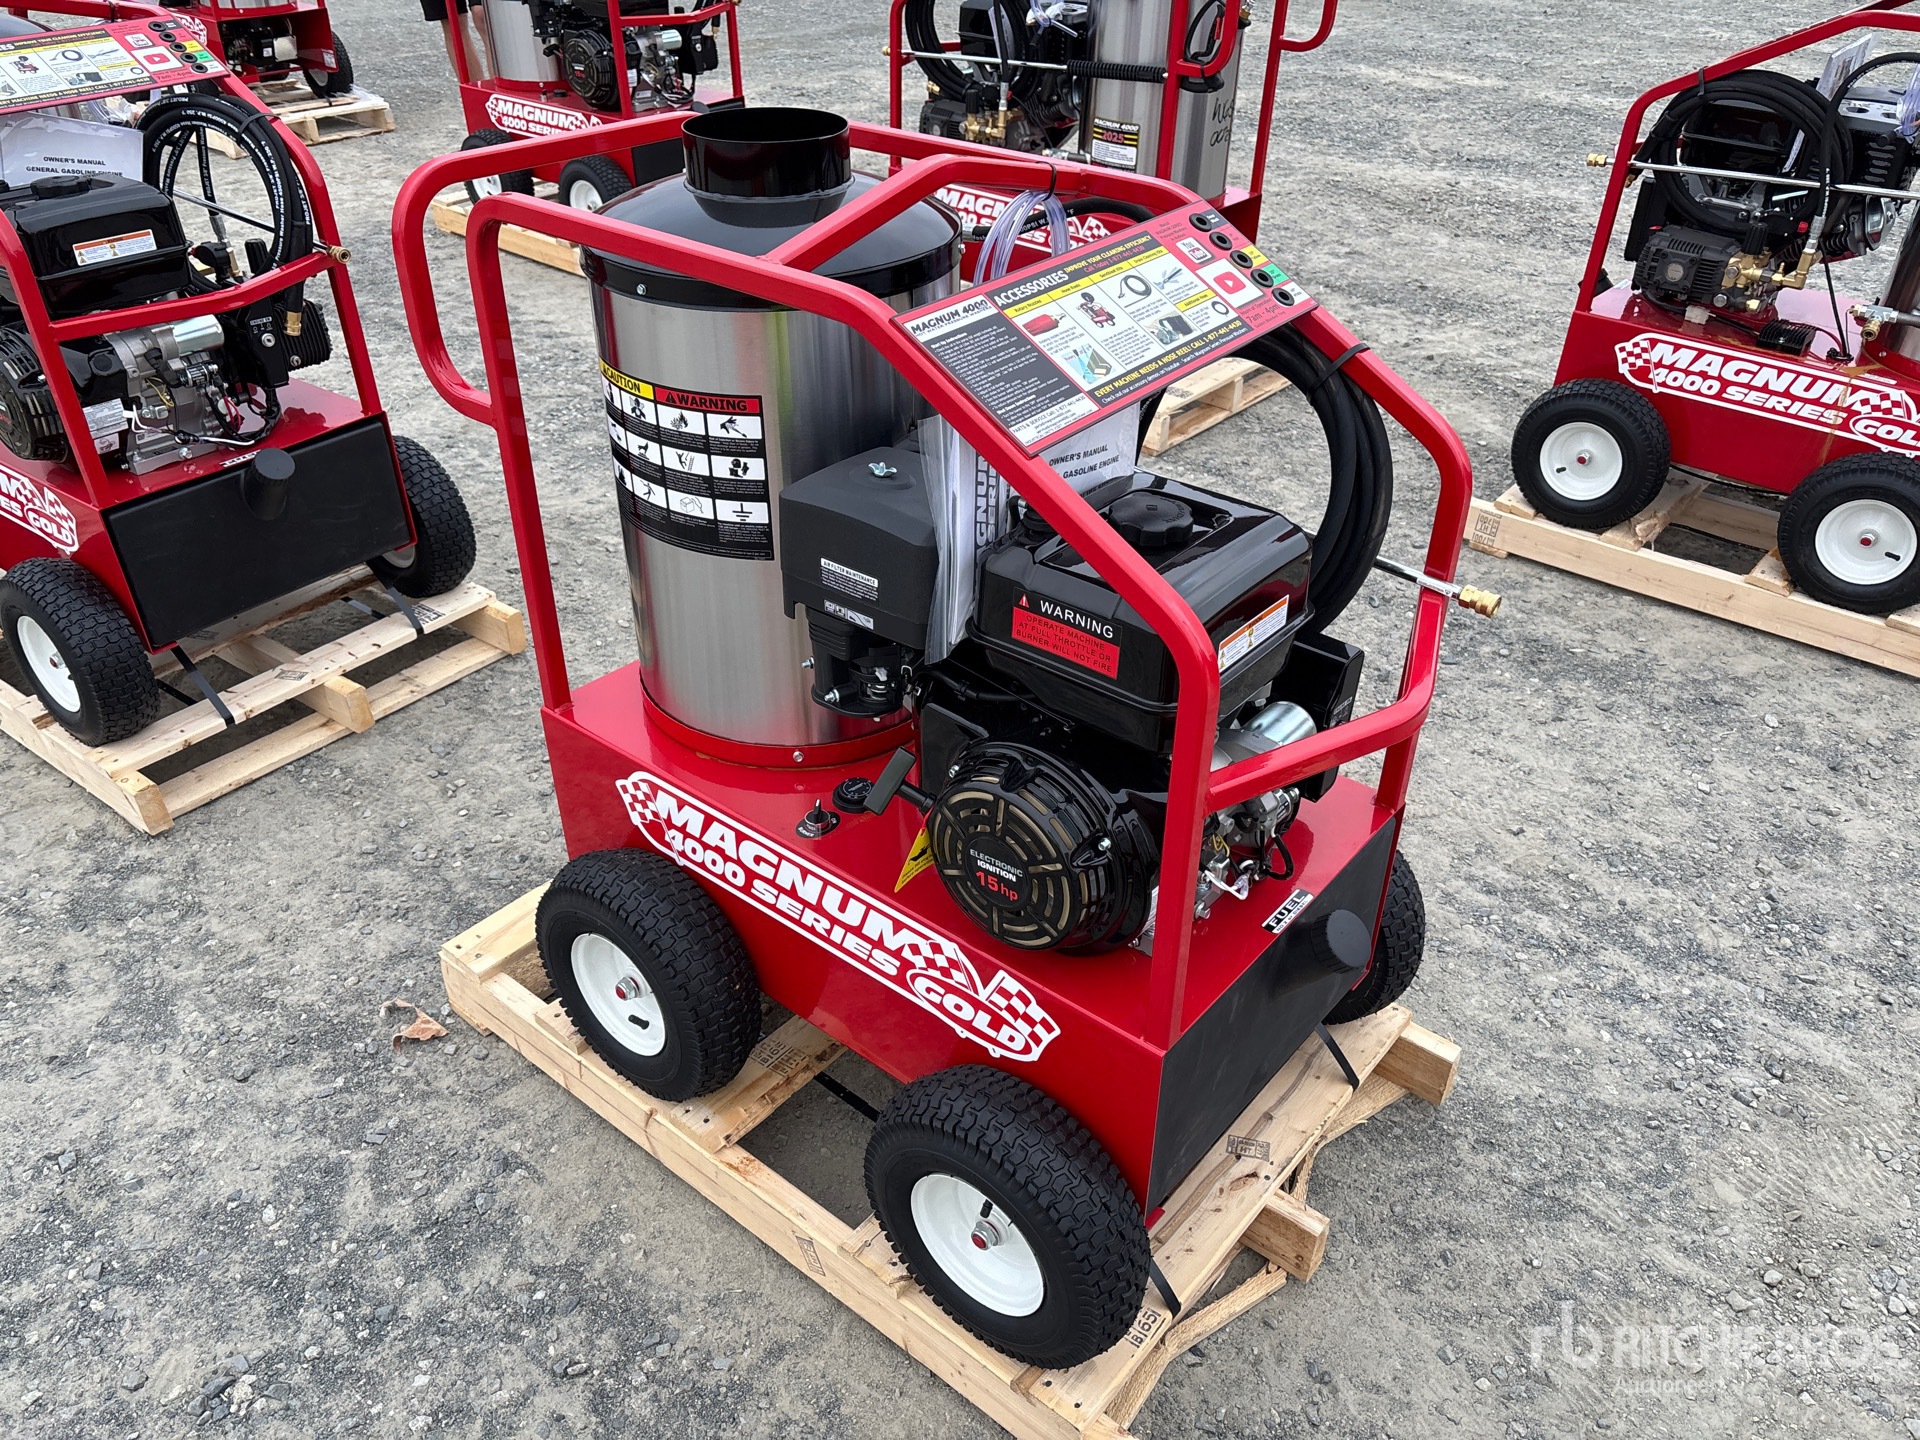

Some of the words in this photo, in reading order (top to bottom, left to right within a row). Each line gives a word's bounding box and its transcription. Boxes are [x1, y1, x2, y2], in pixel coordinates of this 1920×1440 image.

[497, 100, 575, 128] MAGNUM
[502, 117, 527, 131] 4000
[1094, 117, 1120, 129] MAGNUM
[1101, 130, 1125, 143] 2025
[26, 166, 59, 174] GENERAL
[43, 156, 76, 164] OWNER'S
[1062, 260, 1089, 273] IMPROVE
[1085, 254, 1103, 264] YOUR
[1099, 245, 1126, 258] CLEANING
[1123, 234, 1153, 249] EFFICIENCY
[1180, 240, 1195, 249] You
[1092, 259, 1110, 269] Today
[990, 269, 1071, 307] ACCESSORIES
[907, 308, 963, 334] MAGNUM
[958, 298, 990, 315] 4000
[1013, 304, 1028, 312] Rotary
[1245, 311, 1263, 323] 7am
[1263, 302, 1281, 314] 4pm
[1093, 383, 1115, 397] EVERY
[1111, 370, 1142, 388] MACHINE
[1137, 361, 1159, 375] NEEDS
[1160, 352, 1178, 363] HOSE
[1174, 344, 1193, 356] REEL!
[1189, 338, 1206, 349] CALL
[1202, 319, 1243, 342] 1-877-441-4430
[606, 369, 640, 394] CAUTION
[1100, 393, 1116, 404] Check
[1128, 378, 1148, 391] accessory
[1192, 345, 1212, 357] Magnum
[1650, 343, 1863, 409] MAGNUM
[676, 394, 748, 411] WARNING
[1649, 368, 1721, 396] 4000
[1722, 386, 1848, 425] SERIES
[1855, 419, 1920, 447] GOL
[1048, 452, 1081, 467] OWNER'S
[1082, 444, 1108, 459] MANUAL
[1062, 463, 1098, 479] GASOLINE
[1098, 455, 1120, 469] ENGINE
[28, 512, 72, 545] GOLD
[823, 560, 832, 568] AIR
[832, 563, 845, 573] FILTER
[845, 567, 876, 586] MAINTENANCE
[1026, 615, 1064, 634] OPERATE
[1067, 630, 1105, 651] MACHINE
[1040, 600, 1113, 639] WARNING
[1017, 629, 1049, 647] BURNER
[1052, 643, 1070, 655] WILL
[1073, 652, 1090, 664] NOT
[1093, 660, 1112, 672] FIRE
[1019, 621, 1028, 629] AT
[1032, 625, 1050, 639] FULL
[1054, 633, 1096, 657] THROTTLE
[1099, 653, 1111, 663] OR
[798, 826, 814, 837] BURNER
[656, 790, 914, 956] MAGNUM
[970, 849, 1023, 877] ELECTRONIC
[977, 859, 1017, 882] IGNITION
[664, 828, 745, 887] 4000
[751, 877, 900, 977] SERIES
[1269, 896, 1305, 927] FUEL
[914, 980, 1027, 1053] GOLD
